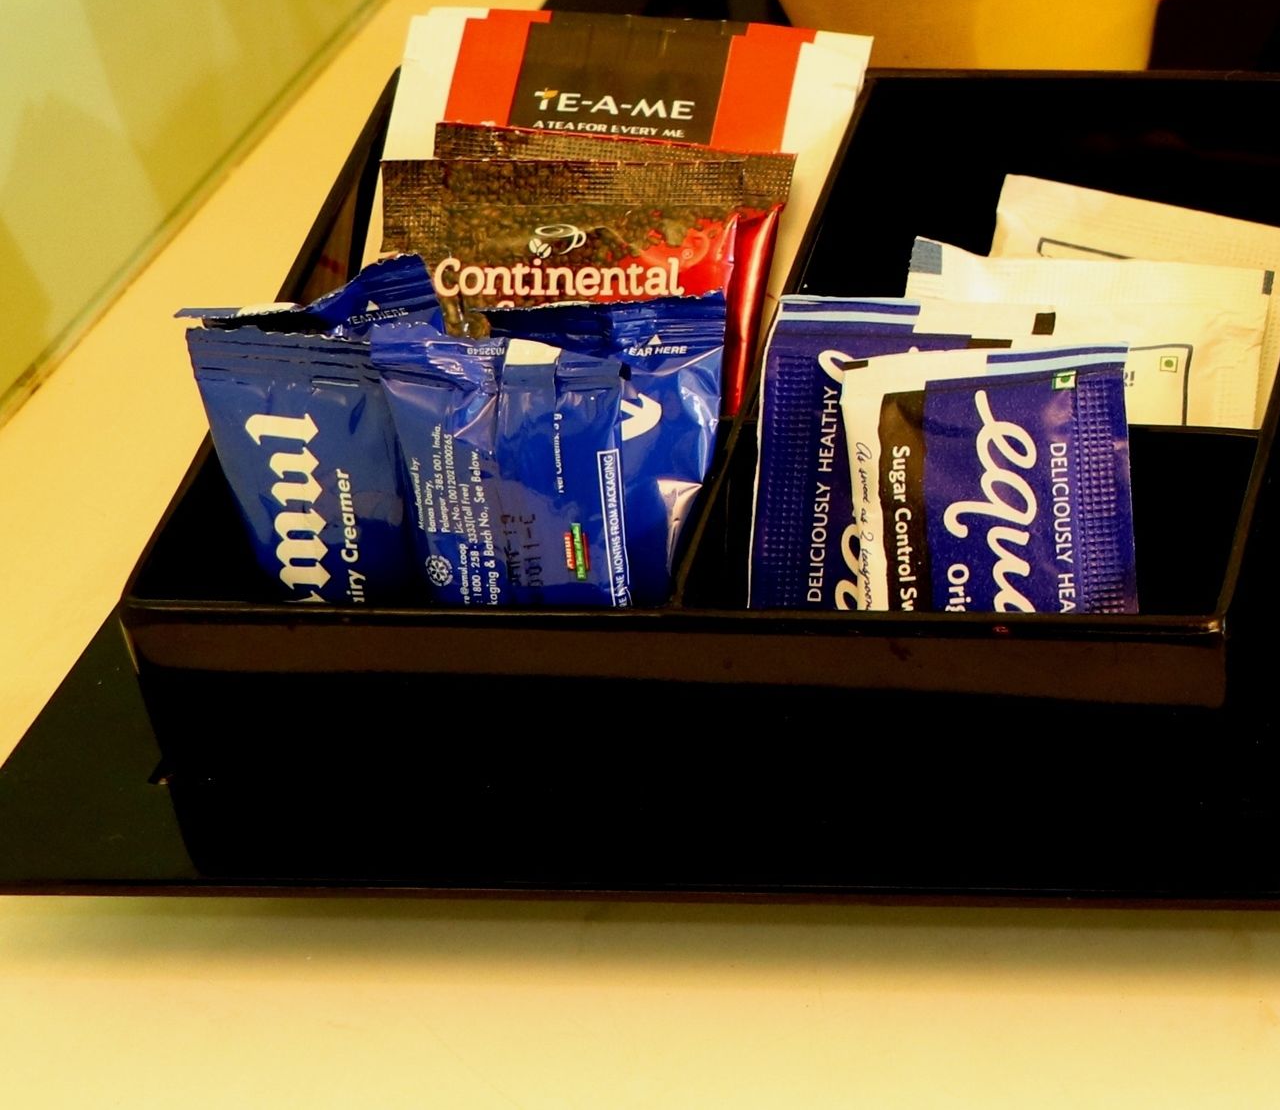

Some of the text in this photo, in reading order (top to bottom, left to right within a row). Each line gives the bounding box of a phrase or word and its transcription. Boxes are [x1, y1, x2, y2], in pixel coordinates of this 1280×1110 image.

[534, 88, 696, 121] TE-A-ME
[532, 119, 686, 138] A TEA FOR EVERY ME
[434, 256, 686, 298] Continental
[623, 345, 689, 358] EAR HERE
[470, 449, 483, 483] Below.
[855, 441, 873, 462] As
[435, 473, 444, 491] 385
[603, 454, 618, 508] PACKAGING
[858, 468, 870, 503] sweet
[888, 445, 911, 503] Sugar
[245, 413, 331, 603] mul
[411, 472, 425, 530] Manufactured
[424, 479, 438, 533] Banas Dairy,
[474, 485, 486, 503] See
[806, 385, 839, 603] DELICIOUSLY HEALTHY
[1049, 441, 1074, 564] DELICIOUSLY
[336, 468, 359, 563] Creamer
[438, 497, 452, 533] Palanpur
[607, 509, 619, 536] FROM
[860, 507, 869, 523] as
[481, 530, 495, 557] Batch
[860, 530, 875, 542] 2
[894, 507, 917, 583] Control
[470, 549, 481, 568] 258
[485, 559, 496, 569] &
[610, 535, 624, 574] MONTHS
